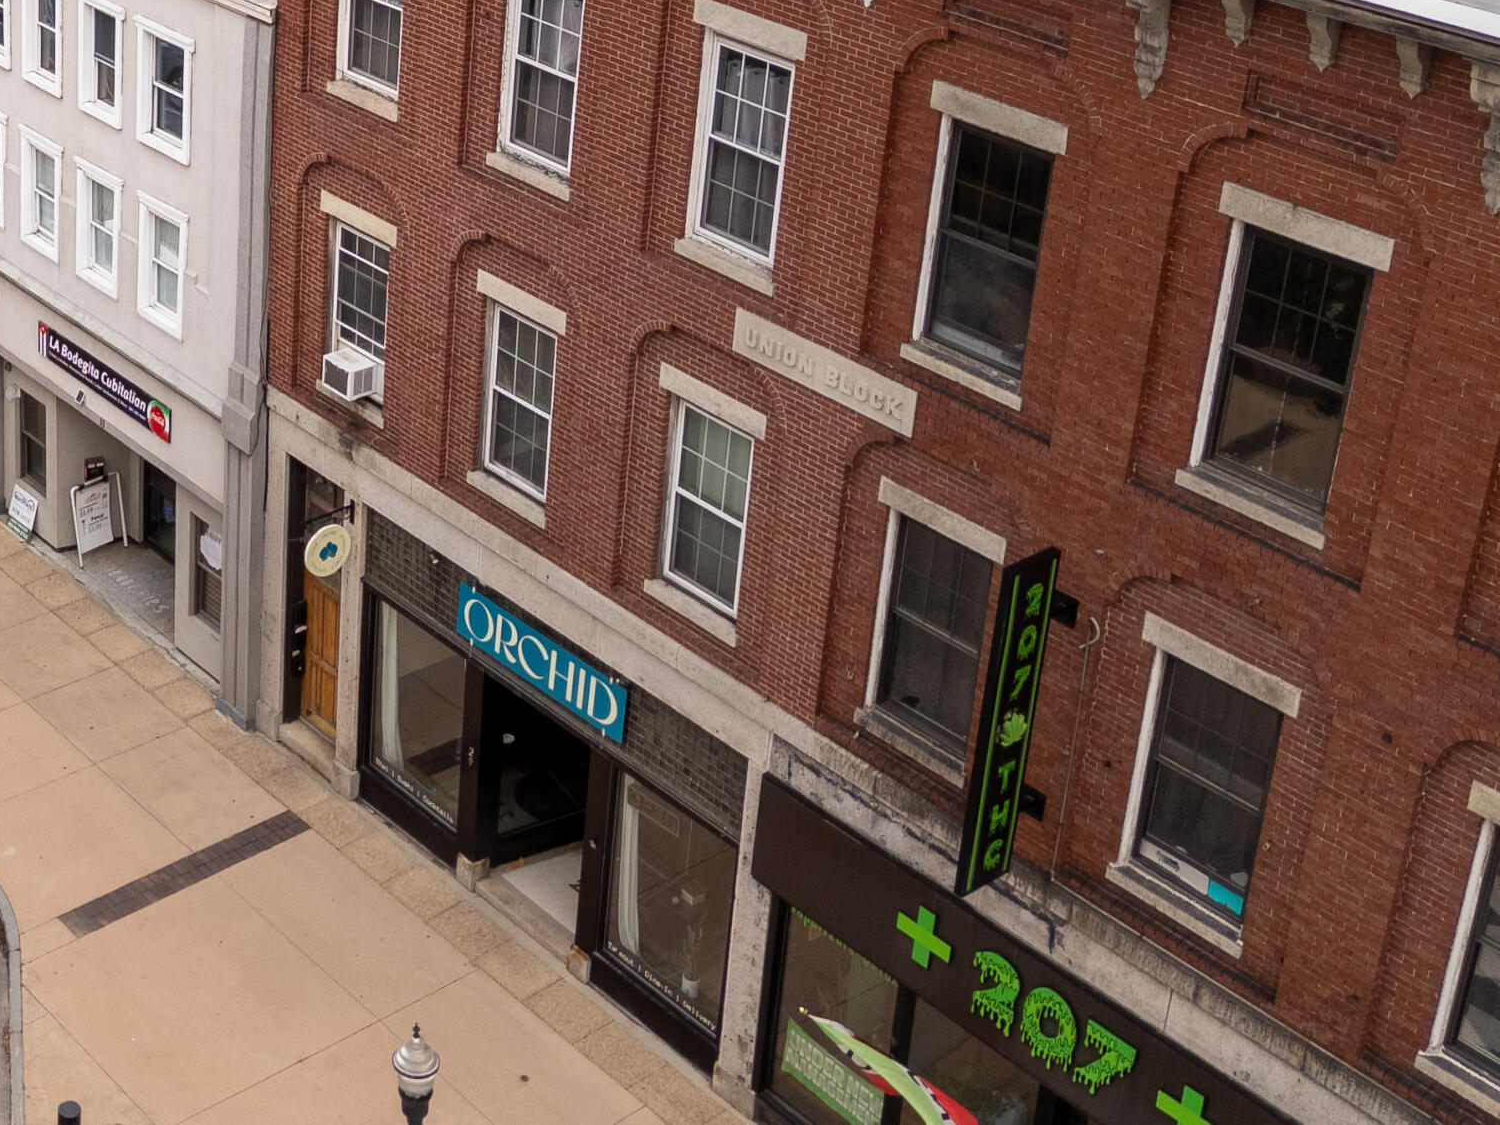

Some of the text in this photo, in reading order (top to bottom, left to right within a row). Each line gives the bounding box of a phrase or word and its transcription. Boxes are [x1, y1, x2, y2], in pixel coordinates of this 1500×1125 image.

[49, 335, 60, 353] LA
[61, 344, 100, 379] Bodegita
[101, 371, 147, 413] Cubitalian
[745, 327, 904, 421] UNION BLOCK
[463, 598, 619, 726] ORCHID
[984, 582, 1044, 871] 207 THC
[970, 950, 1137, 1095] 207
